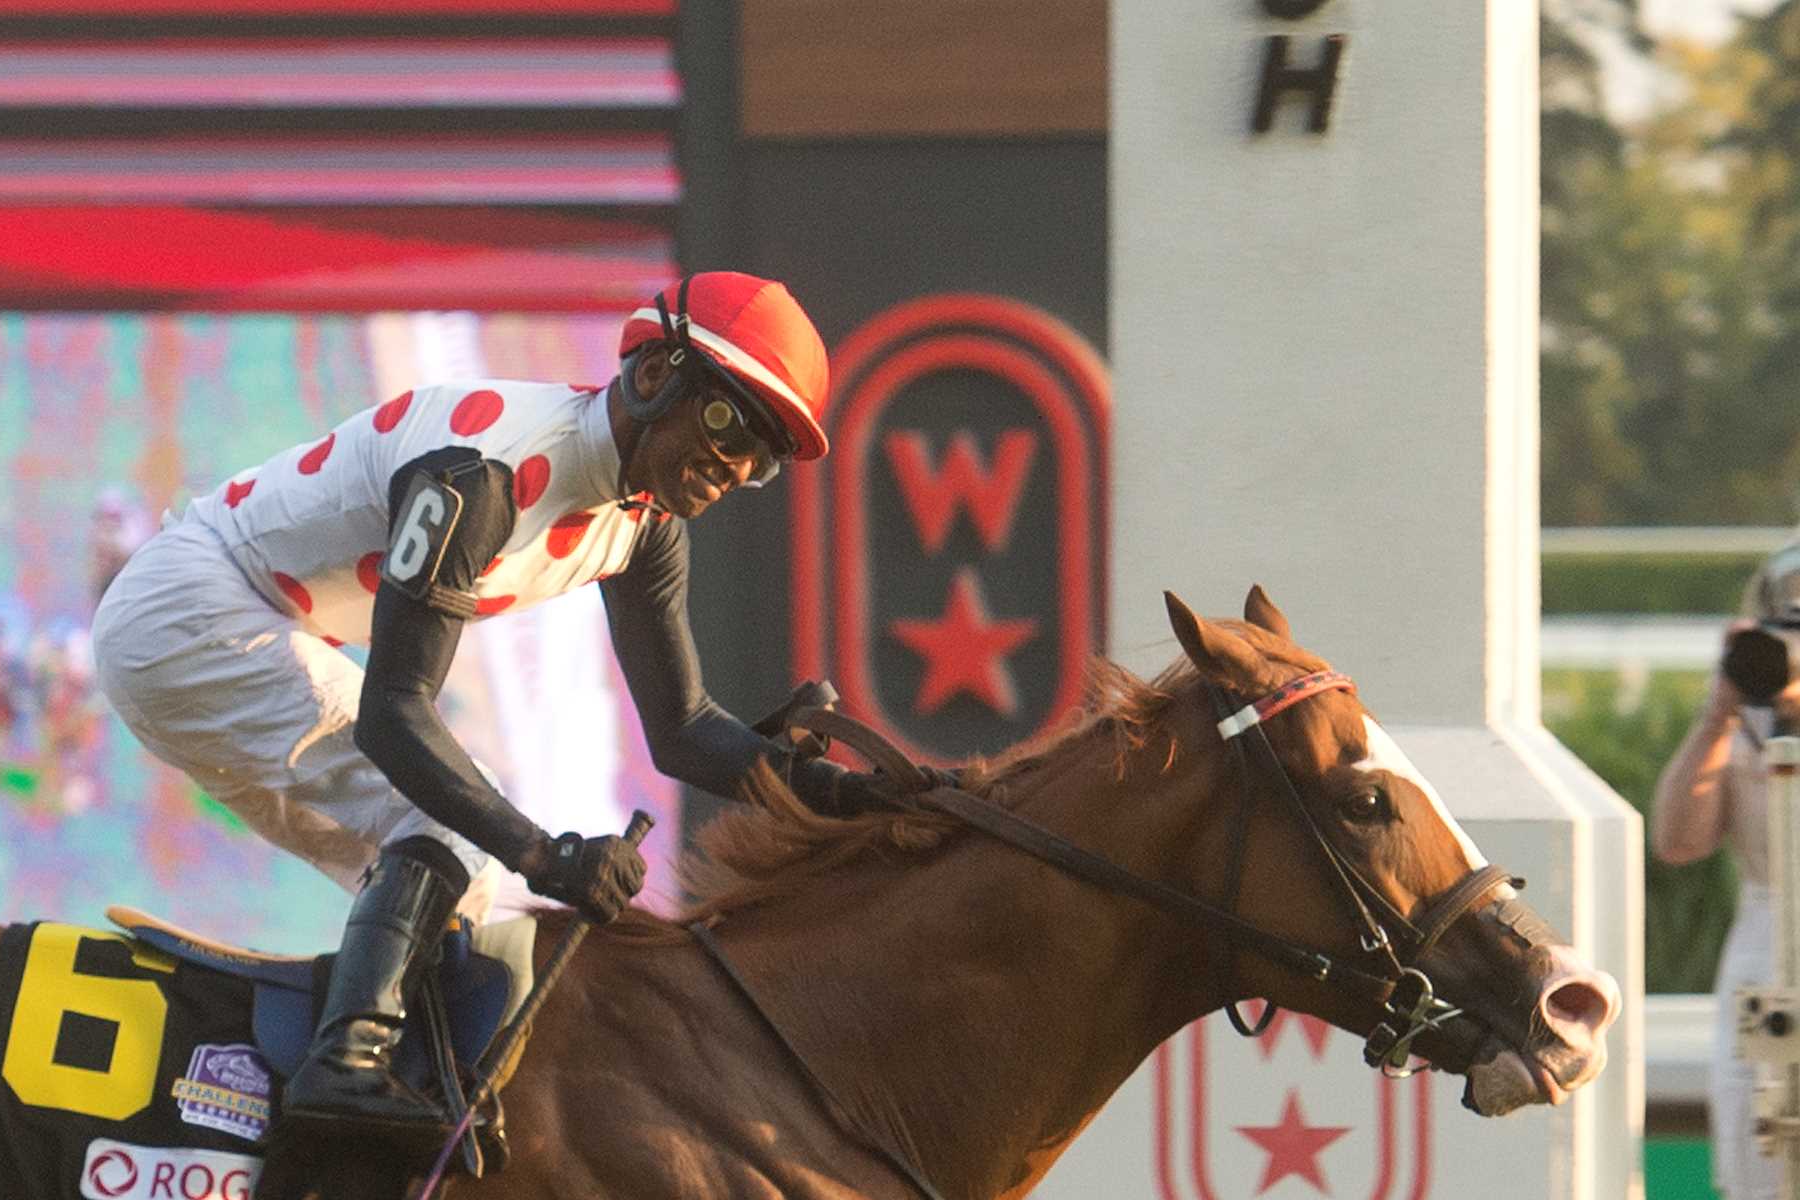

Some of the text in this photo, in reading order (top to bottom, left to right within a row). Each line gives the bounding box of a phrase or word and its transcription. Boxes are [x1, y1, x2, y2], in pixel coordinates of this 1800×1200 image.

[389, 487, 445, 581] 6
[885, 428, 1040, 556] W
[2, 922, 175, 1121] 6
